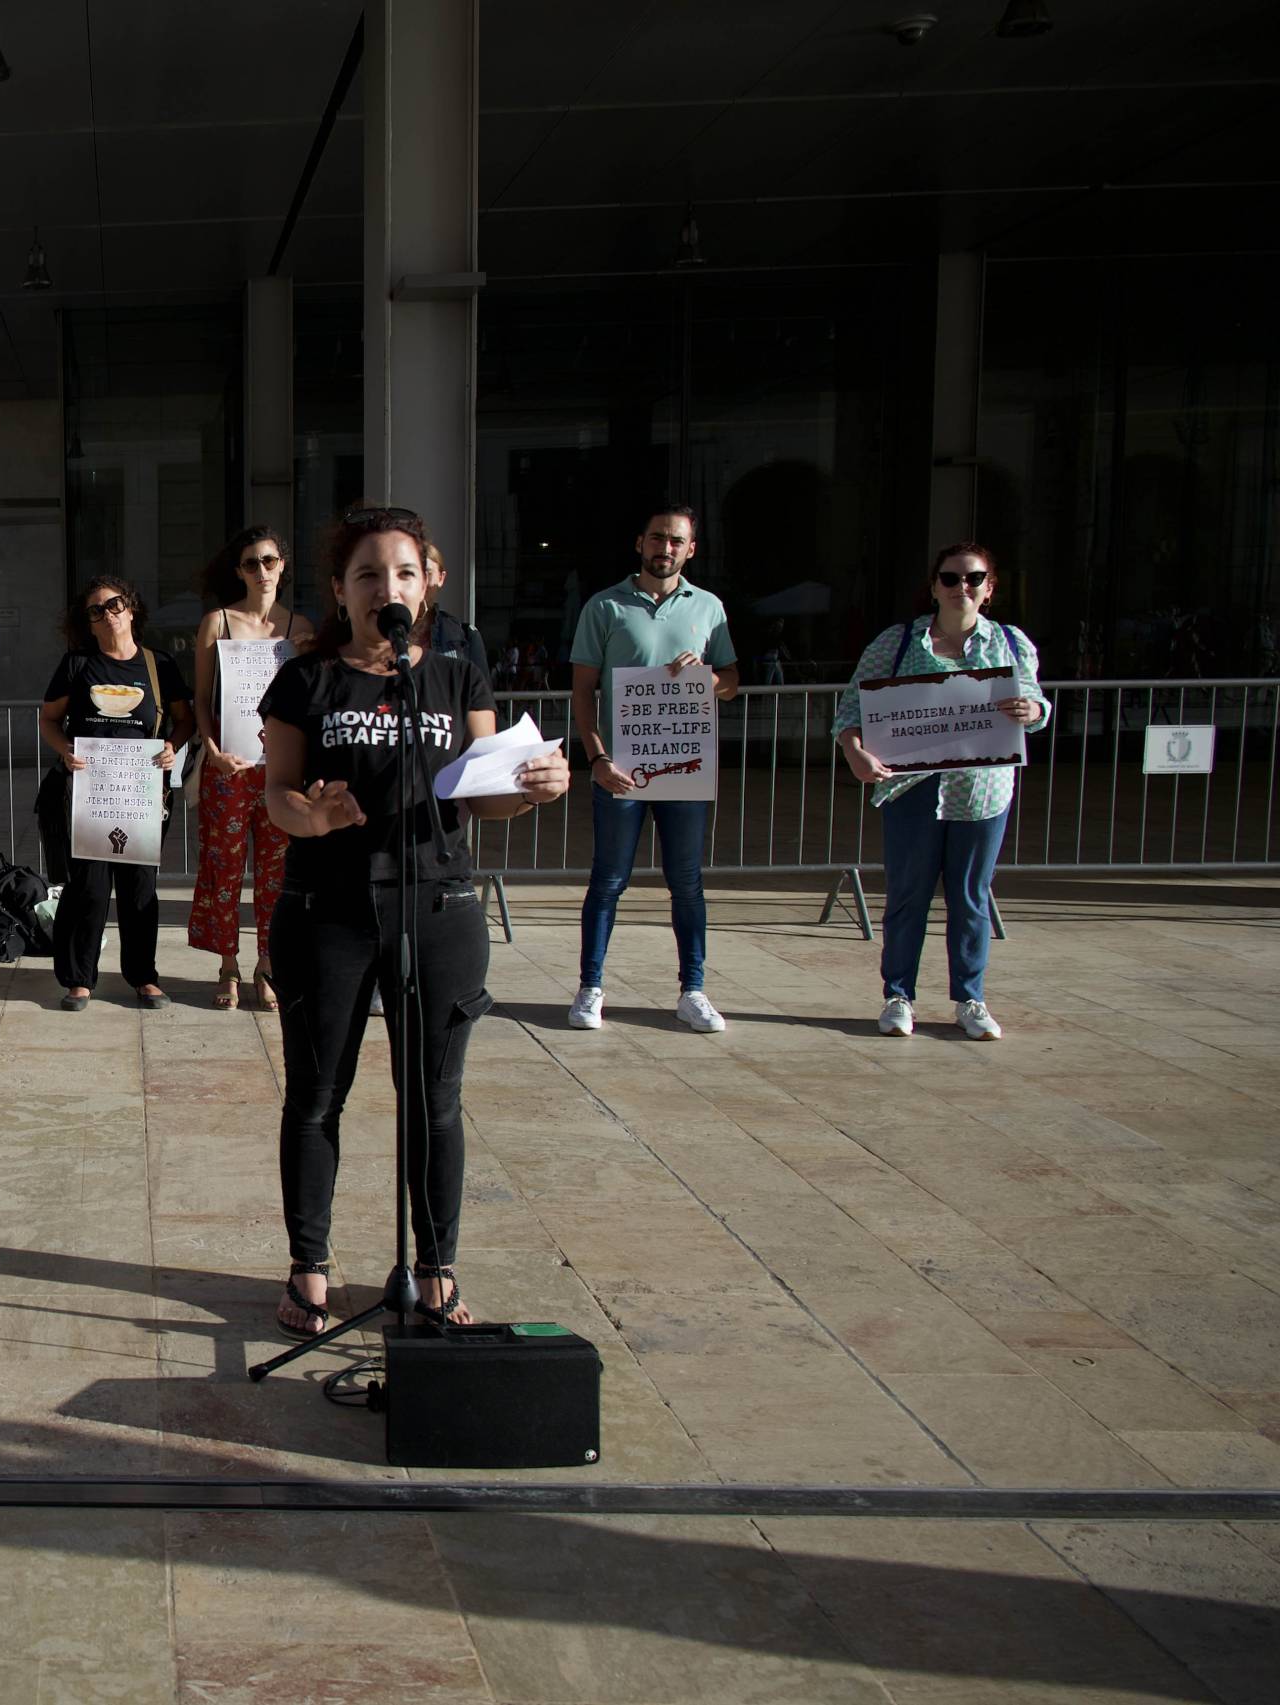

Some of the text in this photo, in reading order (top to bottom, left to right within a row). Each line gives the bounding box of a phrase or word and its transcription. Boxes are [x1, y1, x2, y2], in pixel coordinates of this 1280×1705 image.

[624, 682, 705, 696] FOR US TO
[631, 702, 700, 716] BE FREE
[620, 722, 711, 736] WORK-LIFE
[631, 742, 701, 756] BALANCE
[640, 763, 657, 775] IS
